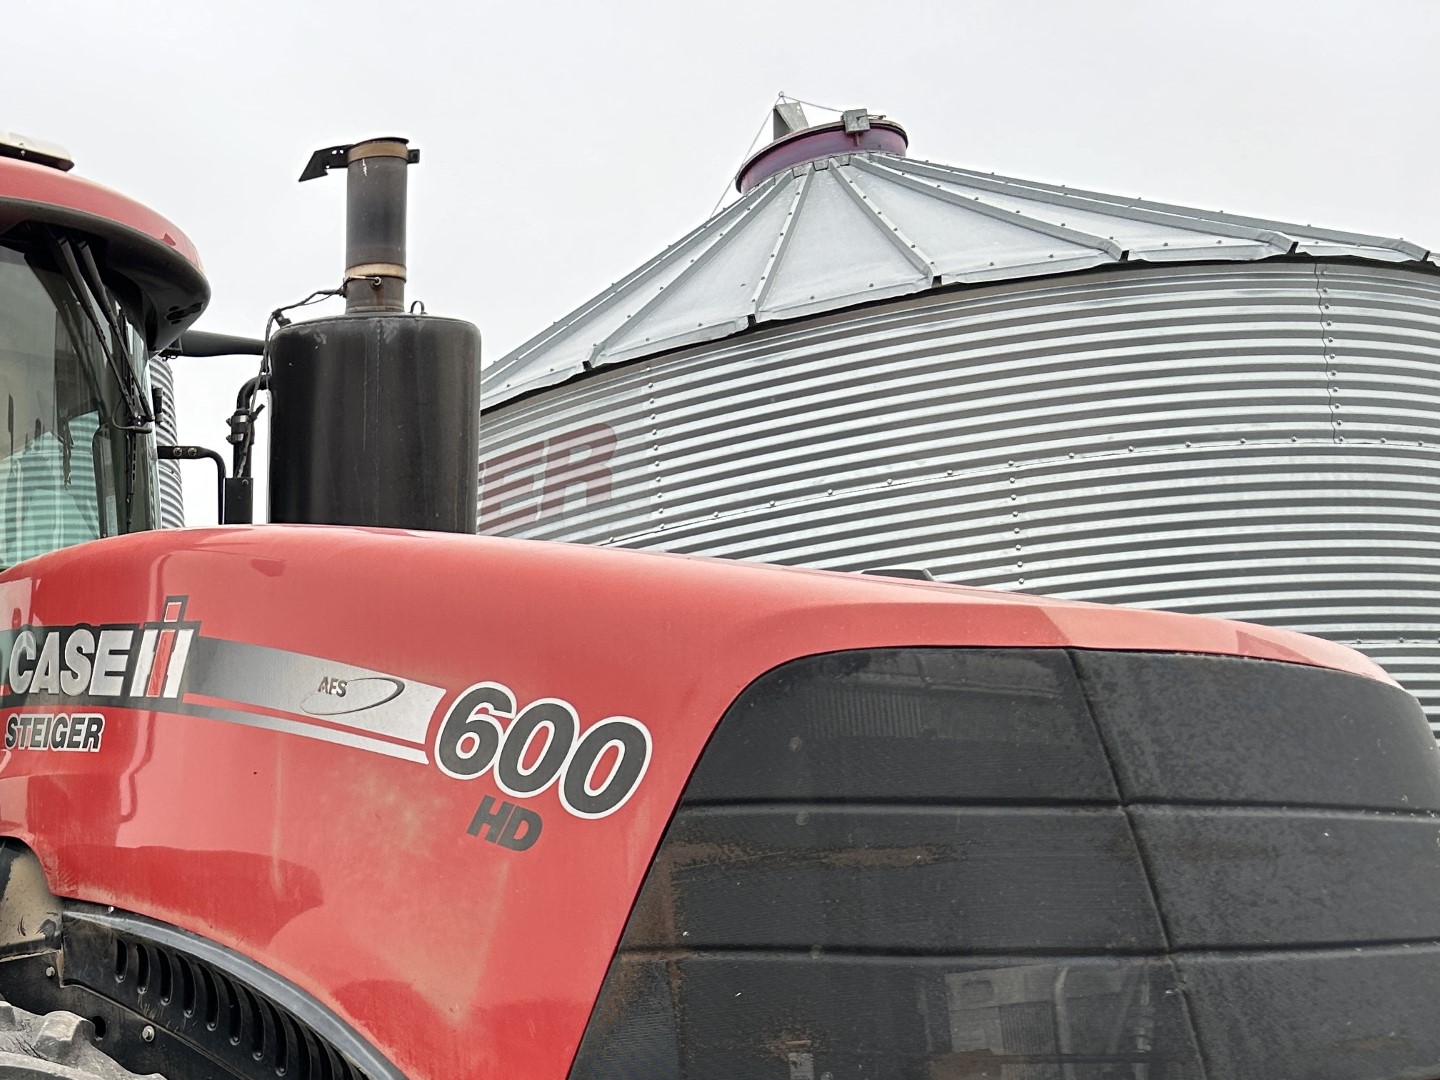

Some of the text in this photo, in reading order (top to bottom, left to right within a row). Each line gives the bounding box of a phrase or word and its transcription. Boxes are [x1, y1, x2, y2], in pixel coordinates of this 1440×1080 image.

[478, 422, 618, 535] ER
[9, 628, 134, 697] CASE
[317, 676, 348, 697] AFS
[5, 713, 105, 752] STEIGER
[435, 681, 653, 820] 600
[466, 794, 544, 852] HD
